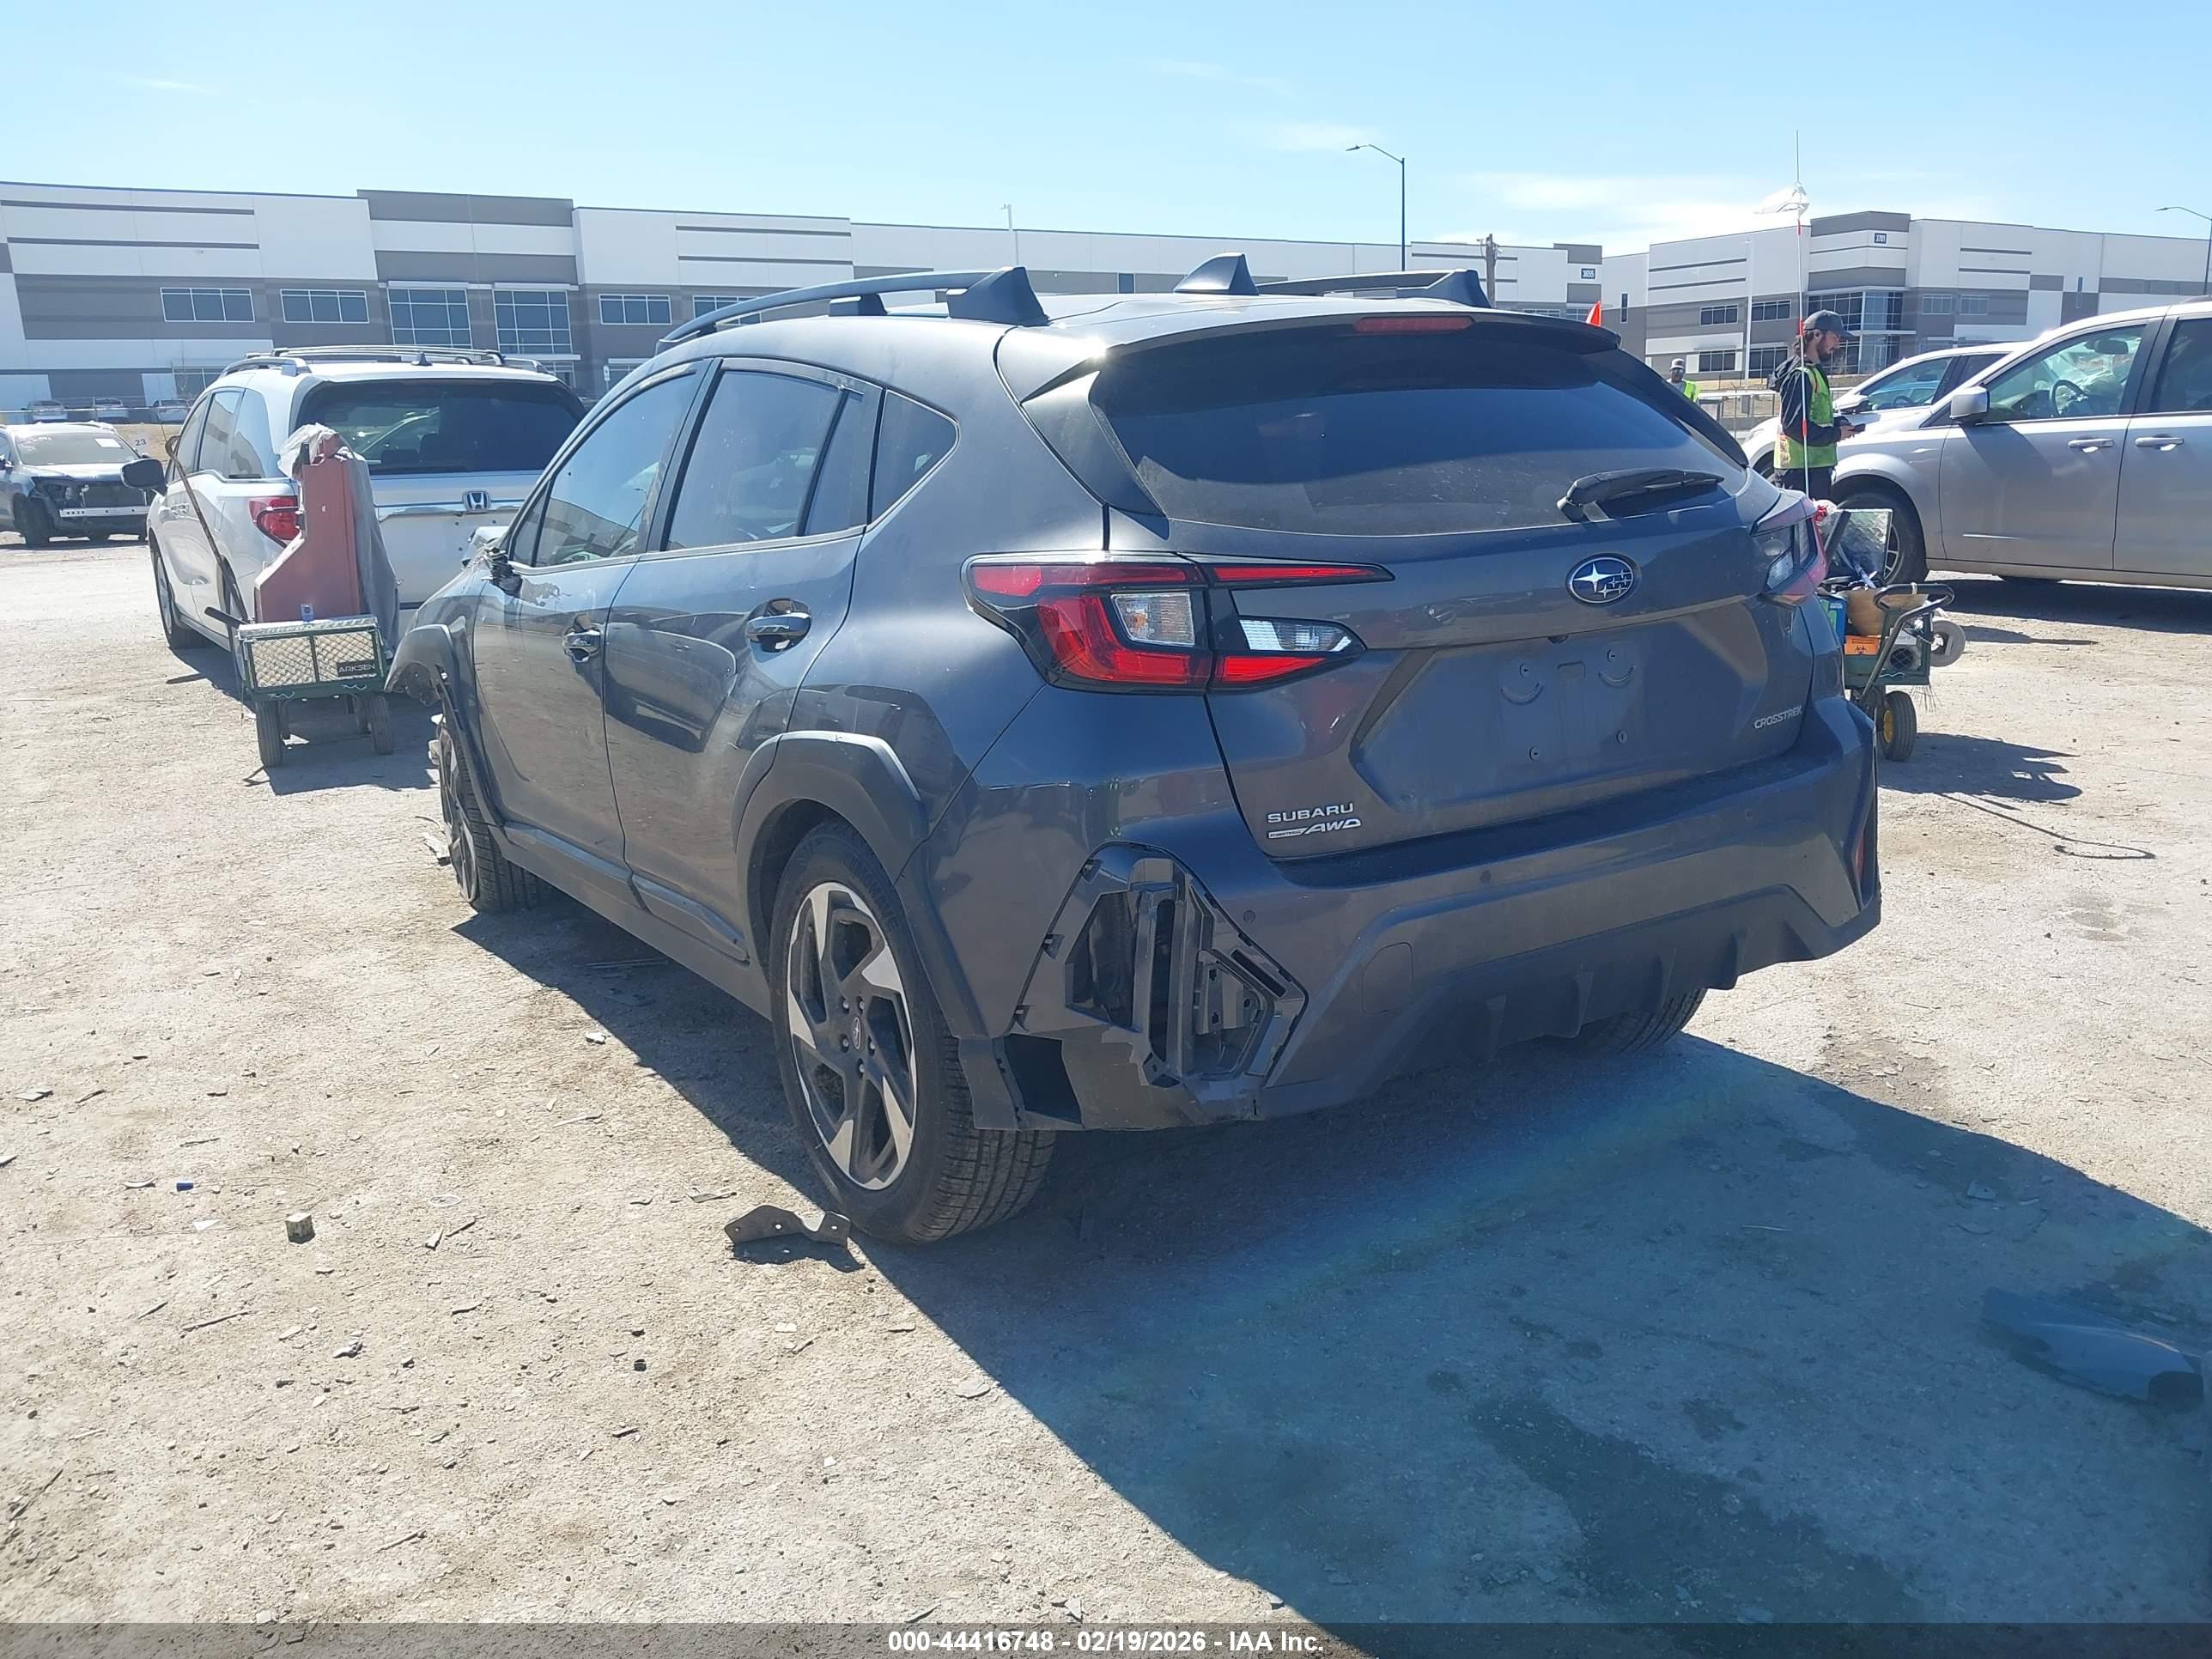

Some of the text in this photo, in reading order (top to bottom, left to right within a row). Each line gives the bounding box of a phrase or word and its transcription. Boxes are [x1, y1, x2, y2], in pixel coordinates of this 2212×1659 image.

[338, 663, 376, 672] ARKSEN
[1754, 705, 1802, 729] CROSSTREK
[1267, 803, 1354, 823] SUBARU
[1304, 818, 1362, 835] AWD
